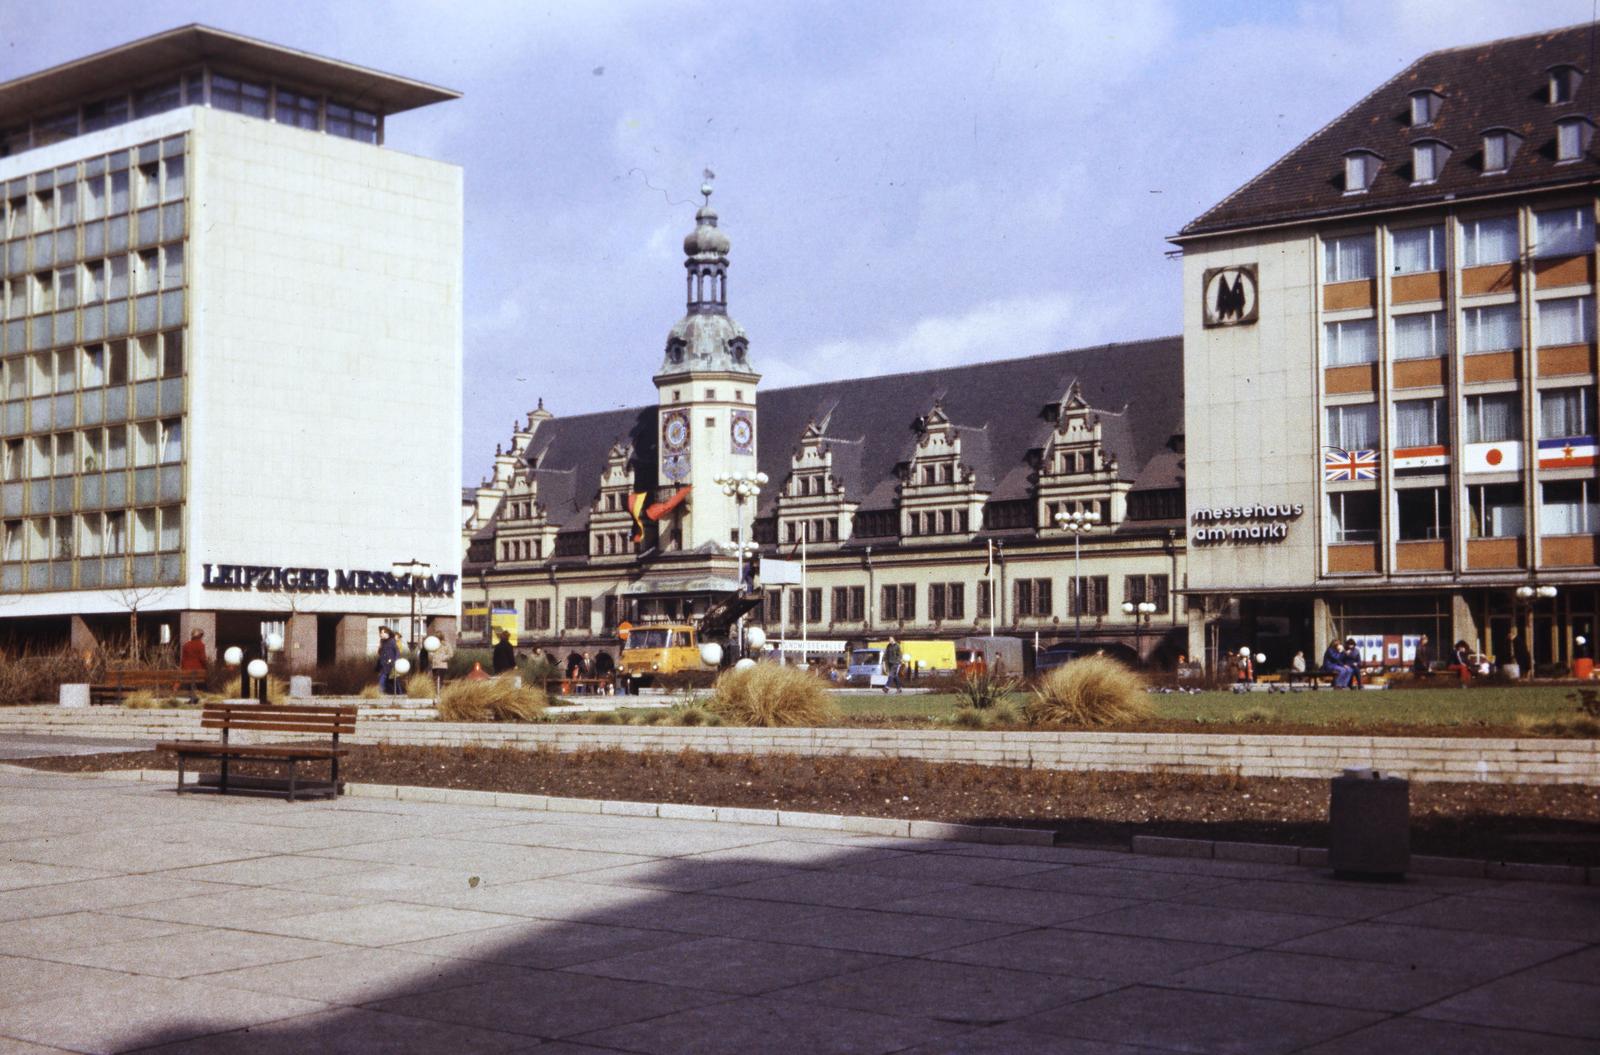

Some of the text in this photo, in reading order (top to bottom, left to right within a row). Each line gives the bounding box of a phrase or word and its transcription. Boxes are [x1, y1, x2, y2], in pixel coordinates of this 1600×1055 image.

[1193, 503, 1304, 522] messehaus
[1195, 522, 1288, 541] am markt
[202, 563, 329, 593] LEIPZIGER
